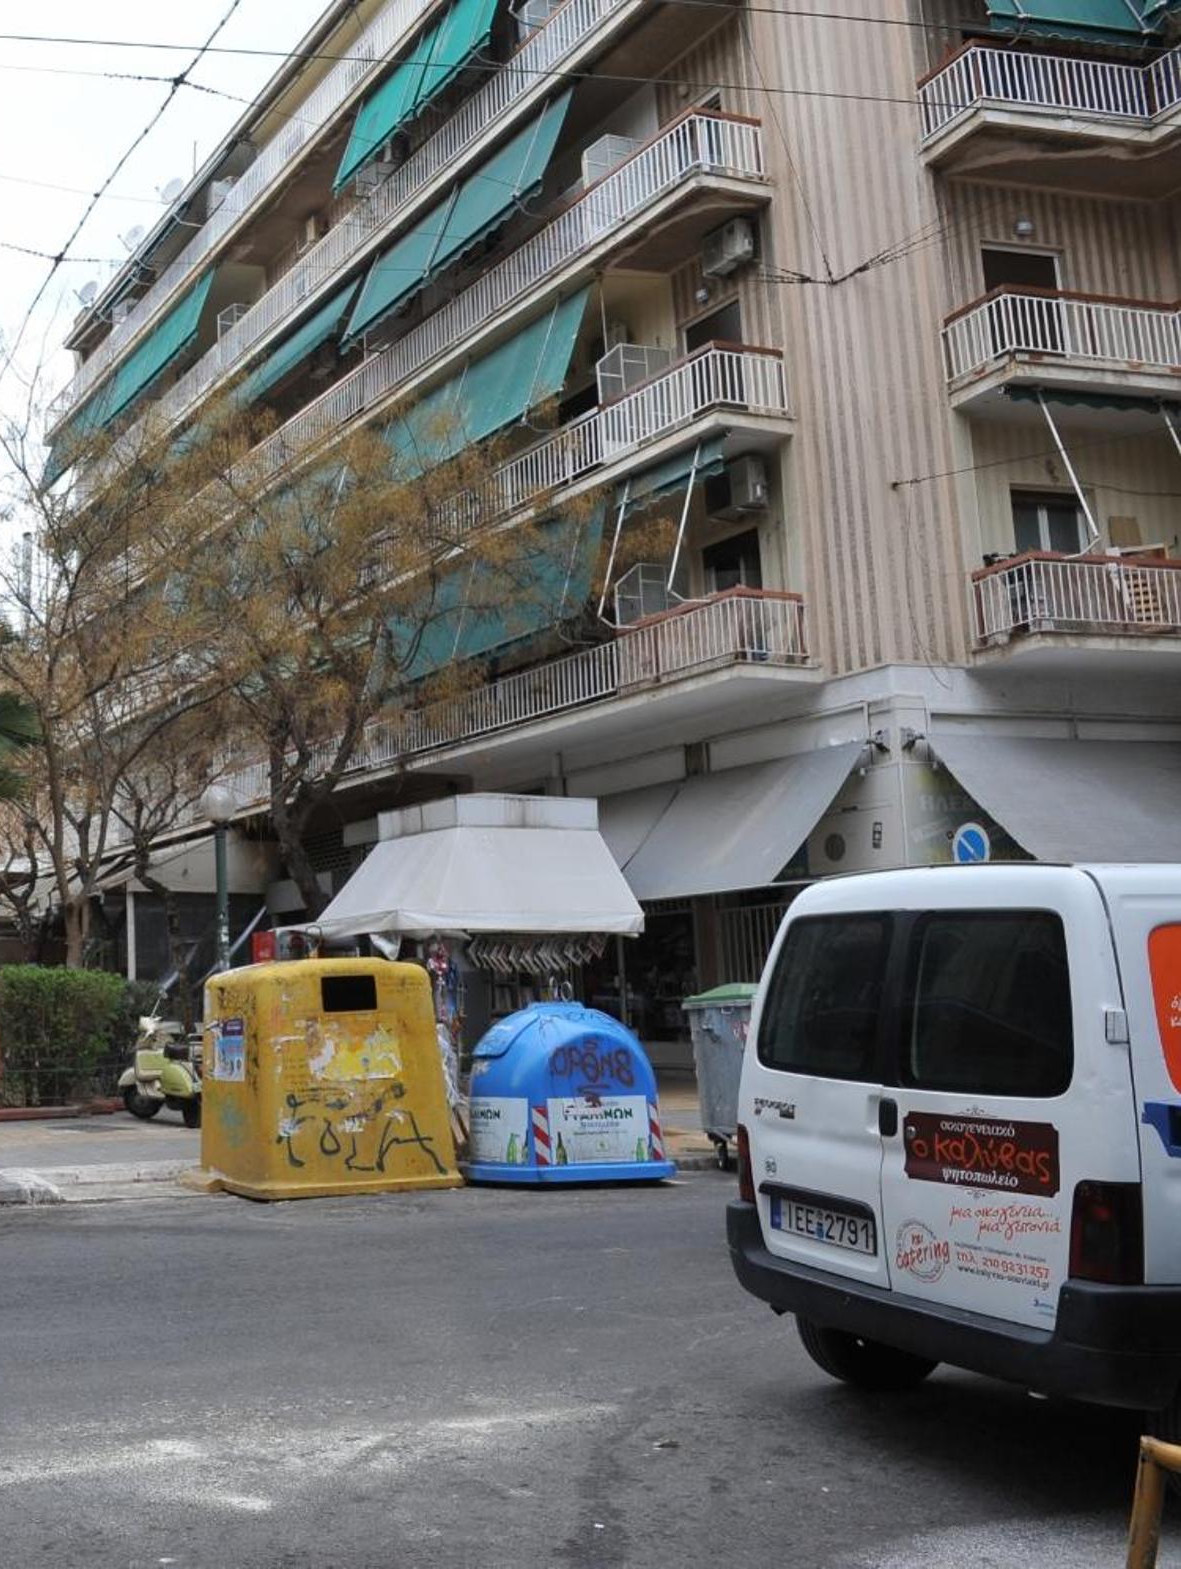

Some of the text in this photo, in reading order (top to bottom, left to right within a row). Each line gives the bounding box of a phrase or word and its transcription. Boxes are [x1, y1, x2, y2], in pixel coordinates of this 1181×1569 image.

[941, 1167, 1019, 1188] ψητοπωλείο
[949, 1205, 973, 1226] μια
[824, 1214, 870, 1250] 2791
[976, 1220, 1001, 1241] μια
[896, 1240, 950, 1270] catering
